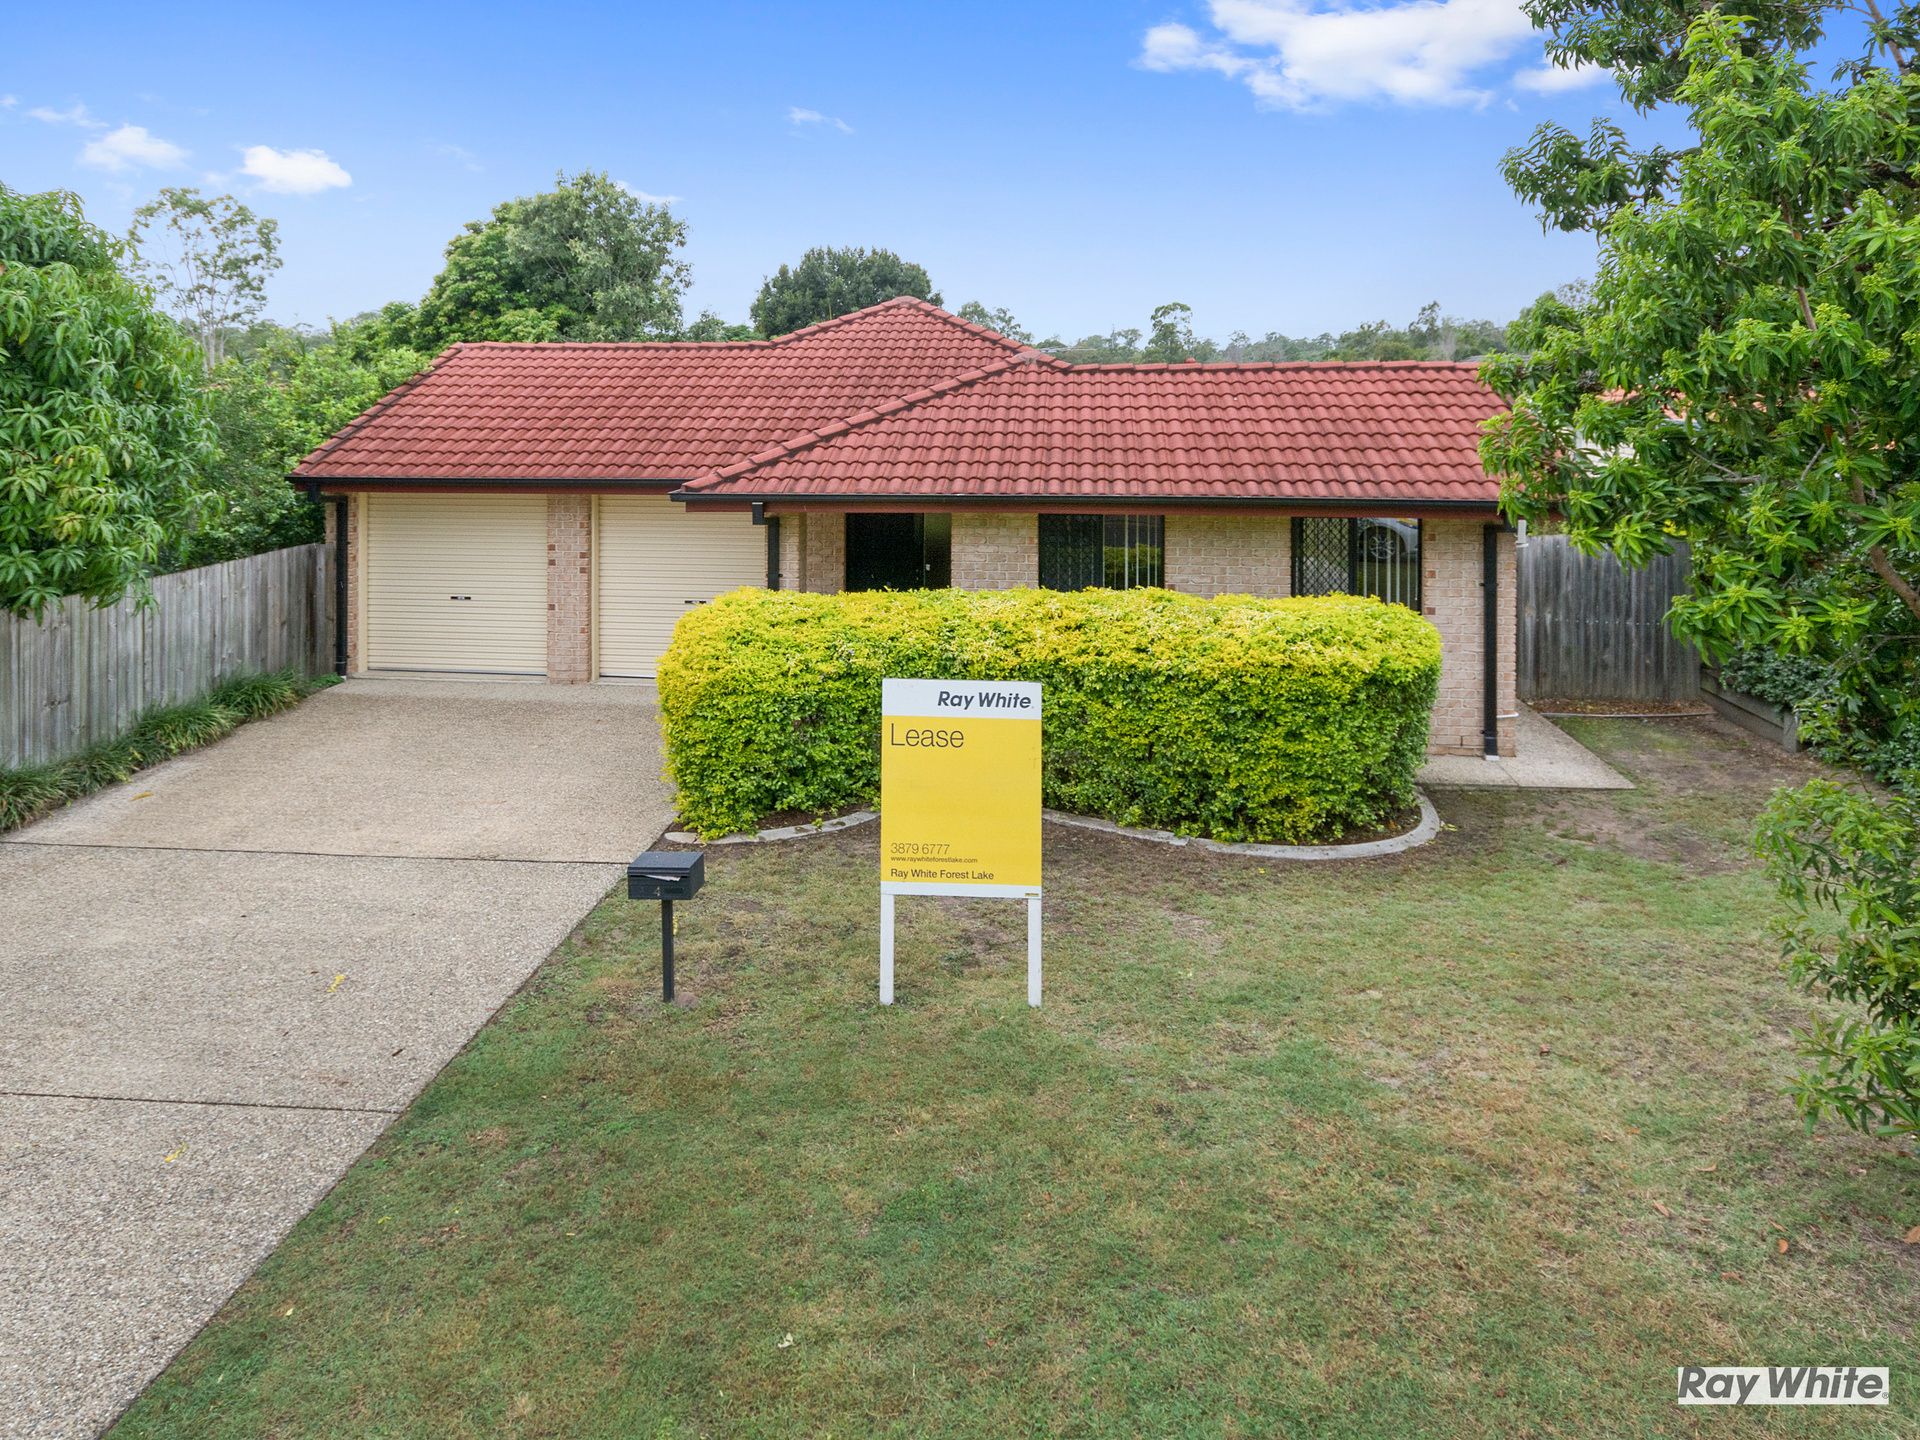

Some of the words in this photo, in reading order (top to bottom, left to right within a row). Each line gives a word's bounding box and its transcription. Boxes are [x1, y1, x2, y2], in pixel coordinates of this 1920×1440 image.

[937, 691, 974, 710] Ray
[979, 692, 1032, 709] White
[890, 723, 964, 748] Lease
[890, 843, 919, 855] 3879
[921, 844, 950, 855] 6777
[890, 855, 978, 864] www.raywhiteforestlake.com
[890, 868, 908, 878] Ray
[911, 869, 938, 879] White
[940, 870, 969, 880] Forest
[971, 870, 994, 880] Lake
